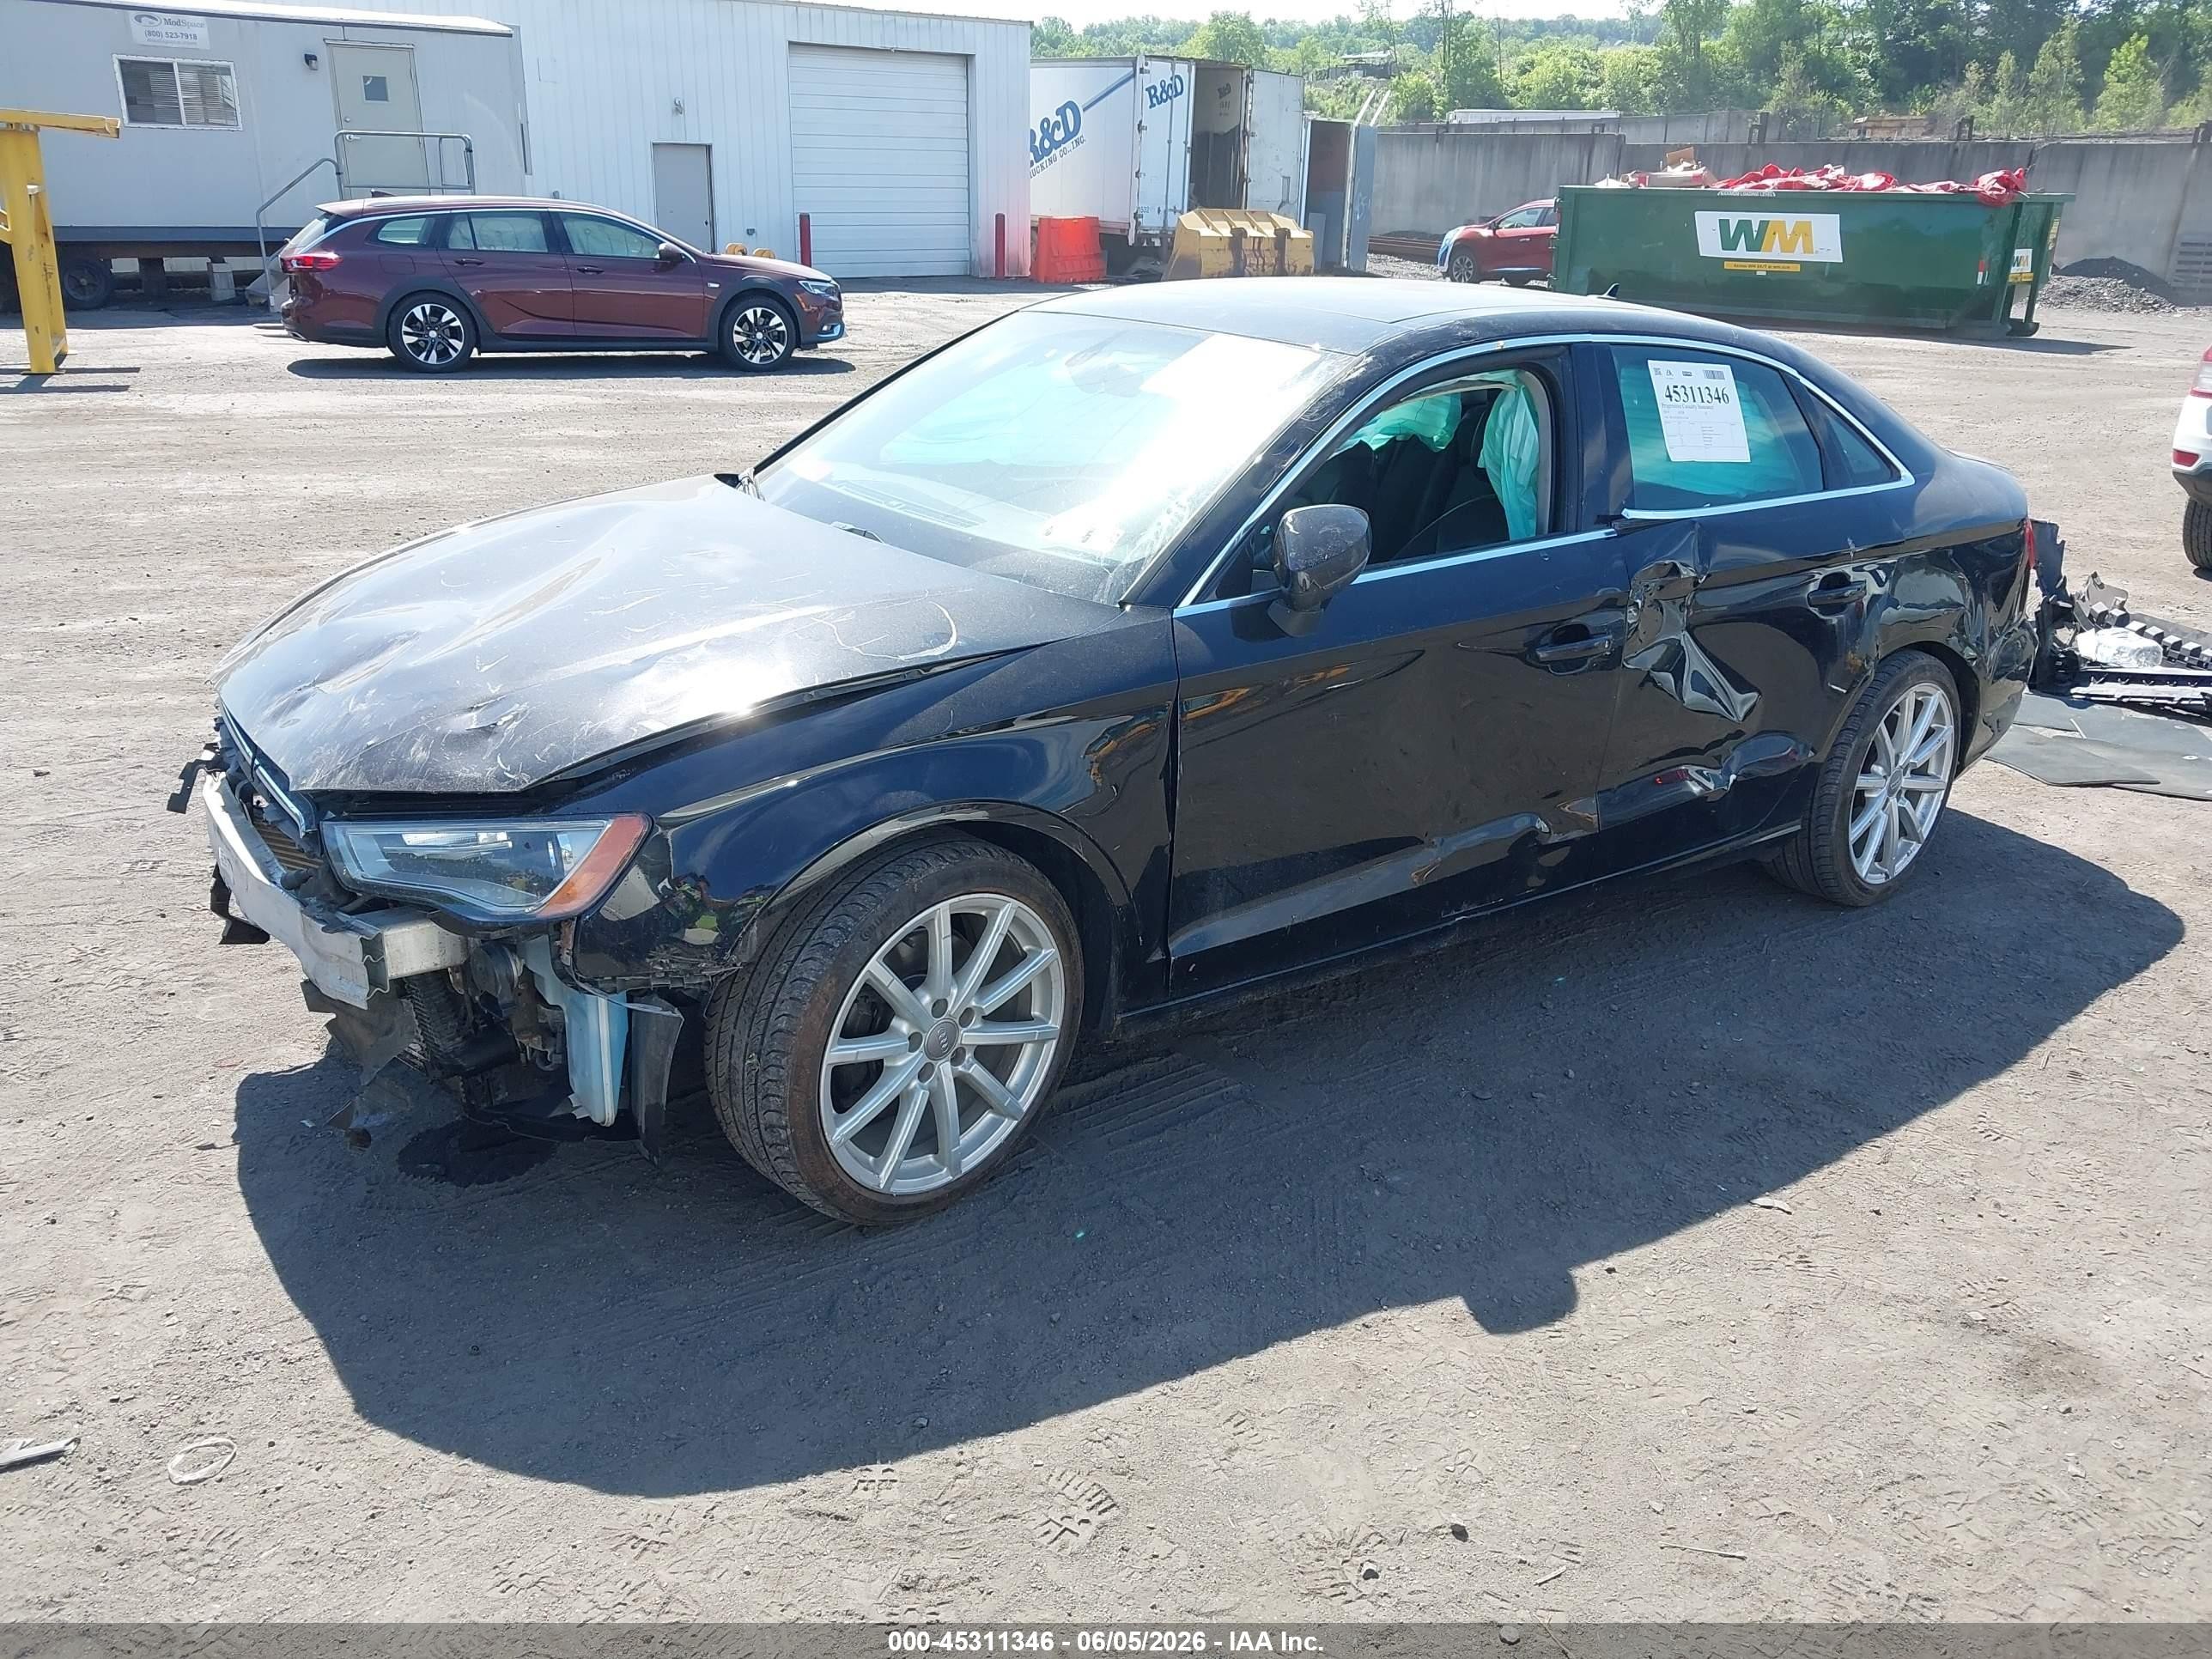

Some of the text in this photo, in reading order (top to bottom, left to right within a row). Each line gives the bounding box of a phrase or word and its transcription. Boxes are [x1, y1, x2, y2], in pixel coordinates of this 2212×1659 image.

[163, 18, 205, 28] ModSpace
[144, 30, 163, 40] (800)
[1146, 75, 1184, 109] R&D
[1718, 218, 1814, 254] WM
[1664, 384, 1729, 404] 45311346
